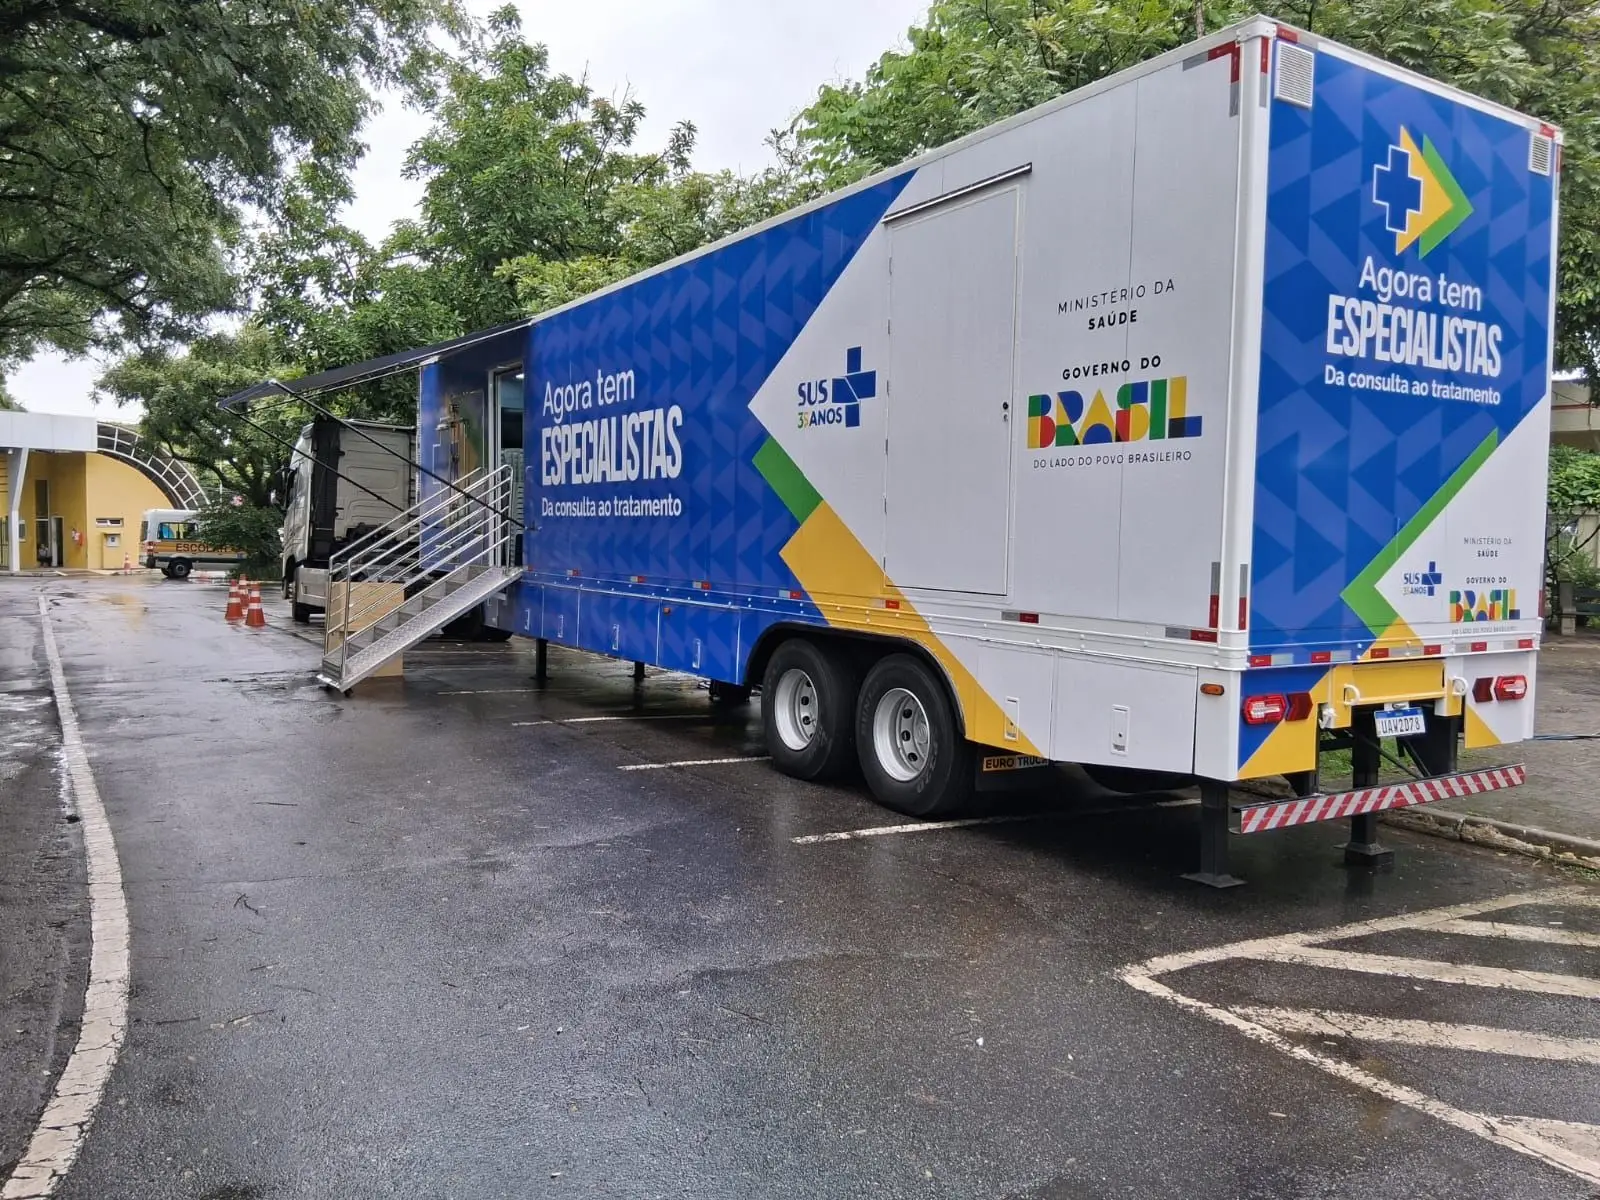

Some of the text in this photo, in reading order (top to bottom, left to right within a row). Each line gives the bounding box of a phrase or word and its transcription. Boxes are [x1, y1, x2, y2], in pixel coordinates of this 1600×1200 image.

[1057, 278, 1175, 315] MINISTÉRIO DA
[1358, 255, 1482, 312] Agora tem
[1088, 310, 1138, 330] SAÚDE
[1326, 293, 1503, 378] ESPECIALISTAS
[1062, 355, 1161, 380] GOVERNO DO
[542, 368, 635, 424] Agora tem
[797, 379, 828, 406] SUS
[1324, 364, 1501, 405] Da consulta ao tratamento
[1027, 375, 1203, 448] BRASIL
[541, 404, 683, 486] ESPECIALISTAS
[1033, 450, 1192, 469] DO LADO DO POVO BRASILEIRO
[541, 493, 682, 518] Da consulta ao tratamento
[1477, 549, 1499, 557] SAÚDE
[1403, 572, 1420, 585] SUS
[1466, 576, 1507, 585] GOVERNO DO
[1449, 588, 1521, 622] BRASIL
[985, 758, 1014, 769] EURO
